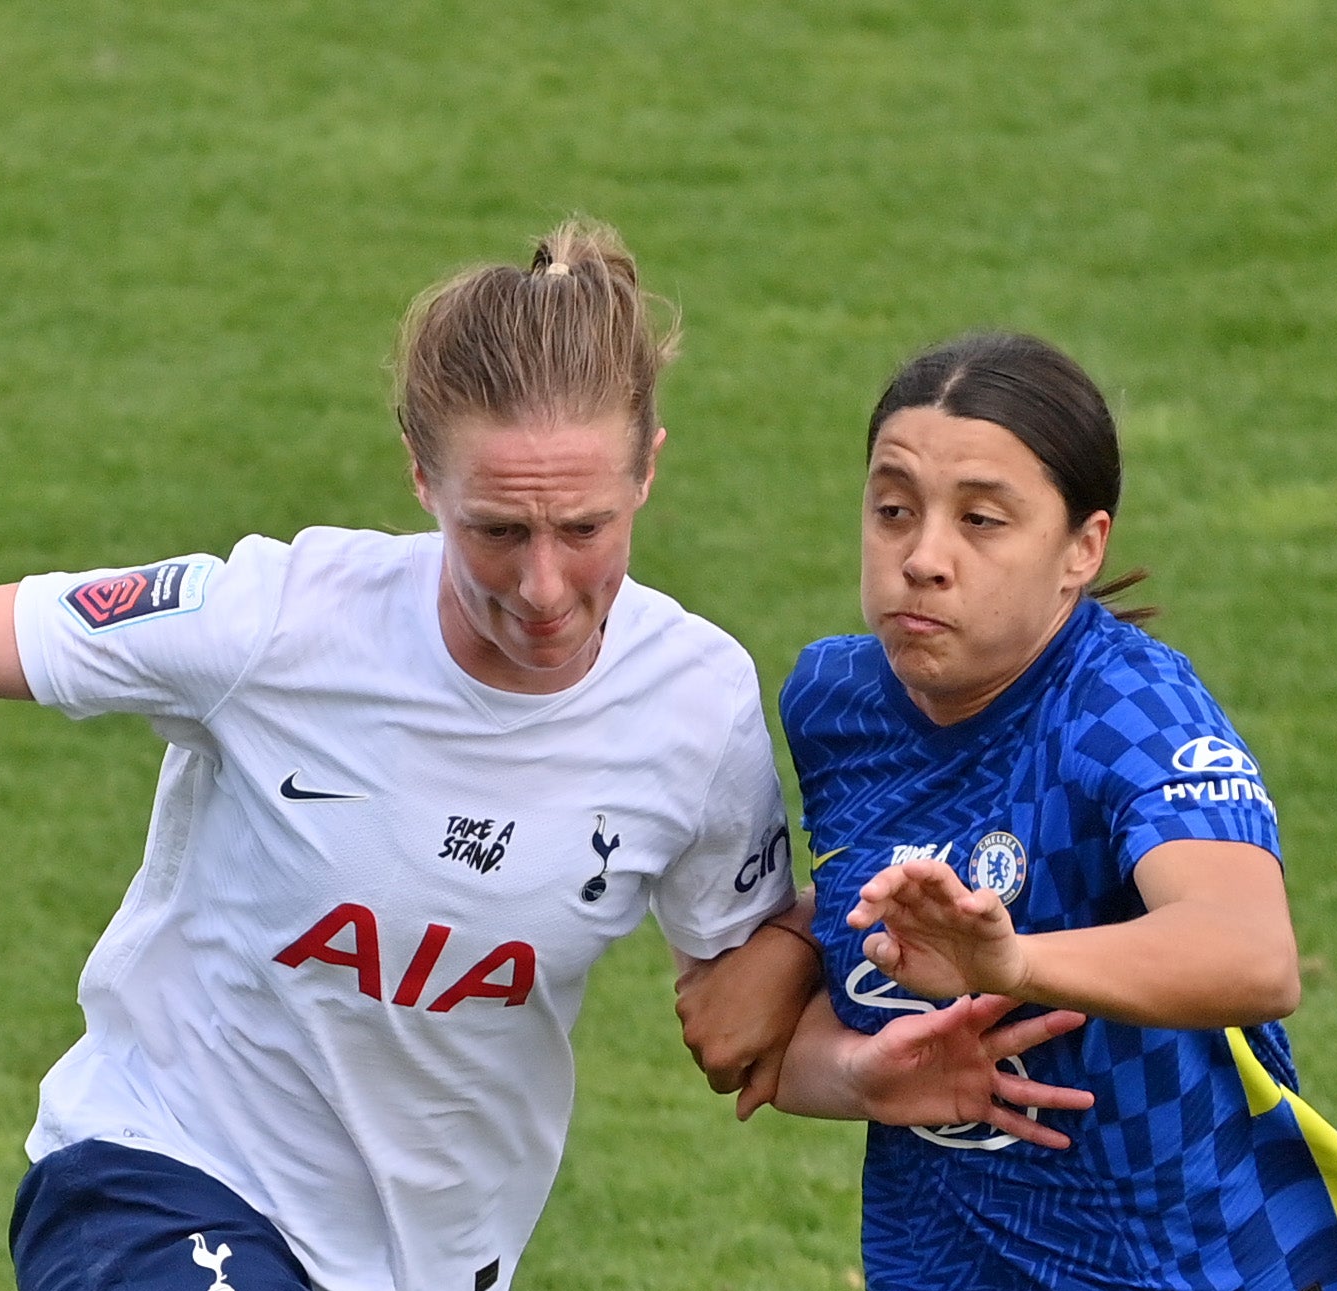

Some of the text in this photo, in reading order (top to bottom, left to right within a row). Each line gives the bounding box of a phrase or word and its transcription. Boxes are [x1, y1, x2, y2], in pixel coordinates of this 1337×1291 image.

[1163, 778, 1277, 825] HYUND
[446, 816, 515, 845] TAKE A
[979, 835, 1017, 851] CHELSEA
[437, 836, 505, 875] STAND.
[271, 903, 537, 1013] AIA
